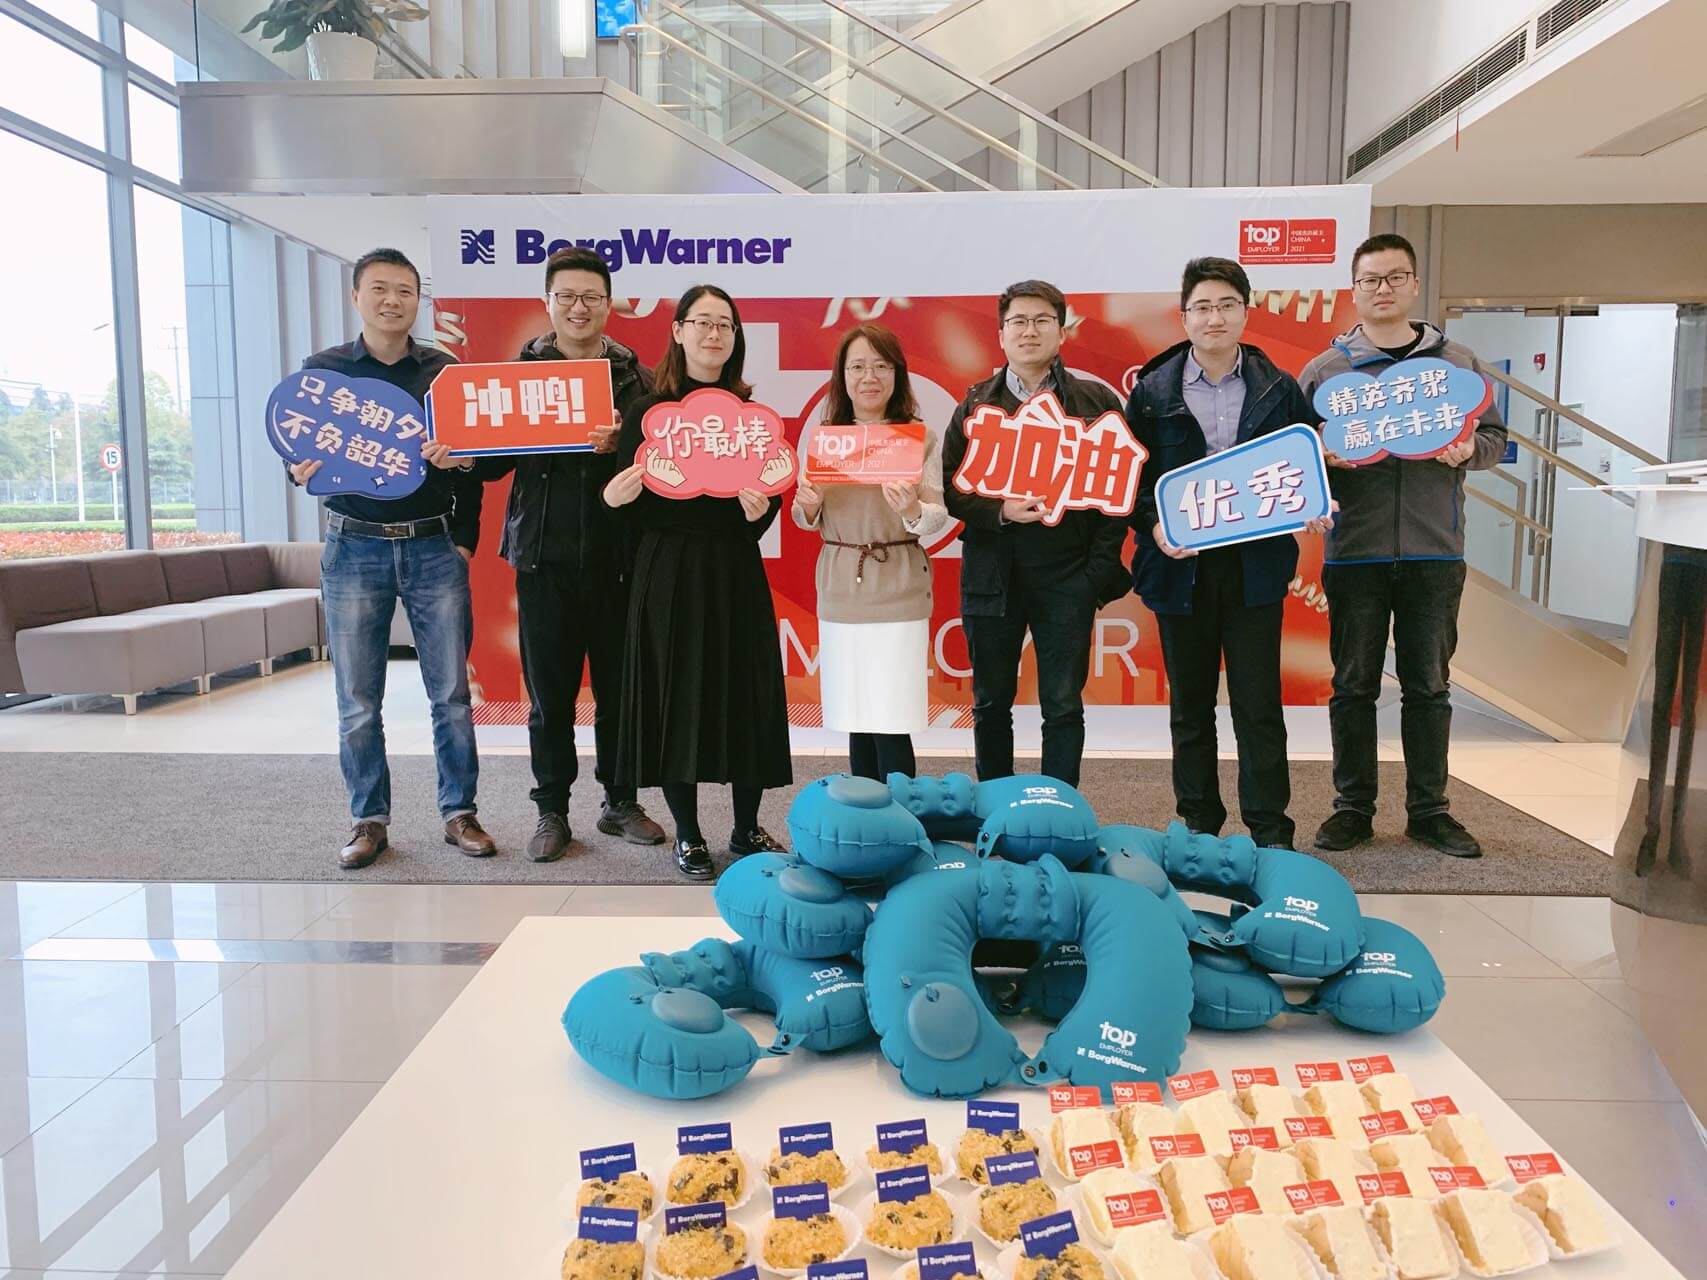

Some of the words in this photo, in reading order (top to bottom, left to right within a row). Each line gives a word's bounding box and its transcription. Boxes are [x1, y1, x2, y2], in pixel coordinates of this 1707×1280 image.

[1244, 224, 1280, 246] top
[1328, 369, 1449, 417] 精英齐聚
[297, 375, 424, 439] 只争朝夕
[1343, 402, 1465, 450] 赢在未来
[280, 409, 412, 477] 不负韶华
[654, 415, 773, 459] 你最棒
[814, 430, 856, 460] top
[106, 451, 118, 465] 15
[962, 413, 1138, 510] 加油
[1179, 460, 1306, 530] 优秀
[1023, 786, 1057, 794] top
[1020, 798, 1074, 808] BorgWarner
[1284, 895, 1319, 911] top
[1275, 912, 1330, 931] BorgWarner
[1361, 952, 1396, 963] top
[810, 966, 843, 981] top
[1356, 967, 1413, 978] BorgWarner
[1099, 1021, 1137, 1049] top
[1099, 1042, 1133, 1057] EMPLOYER
[1088, 1049, 1147, 1074] BorgWarner
[1350, 1060, 1368, 1073] top
[1233, 1071, 1252, 1084] top
[1297, 1066, 1316, 1080] top
[1170, 1077, 1190, 1090] top
[1051, 1089, 1071, 1103] top
[1114, 1085, 1134, 1099] top
[1414, 1101, 1433, 1116] top
[1286, 1119, 1305, 1132] top
[1361, 1116, 1380, 1131] top
[1152, 1139, 1173, 1152] top
[1231, 1132, 1250, 1145] top
[1071, 1150, 1092, 1163] top
[1509, 1157, 1531, 1171] top
[1430, 1169, 1452, 1183] top
[1358, 1178, 1379, 1192] top
[1286, 1188, 1308, 1202] top
[1107, 1199, 1129, 1213] top
[1208, 1196, 1229, 1210] top
